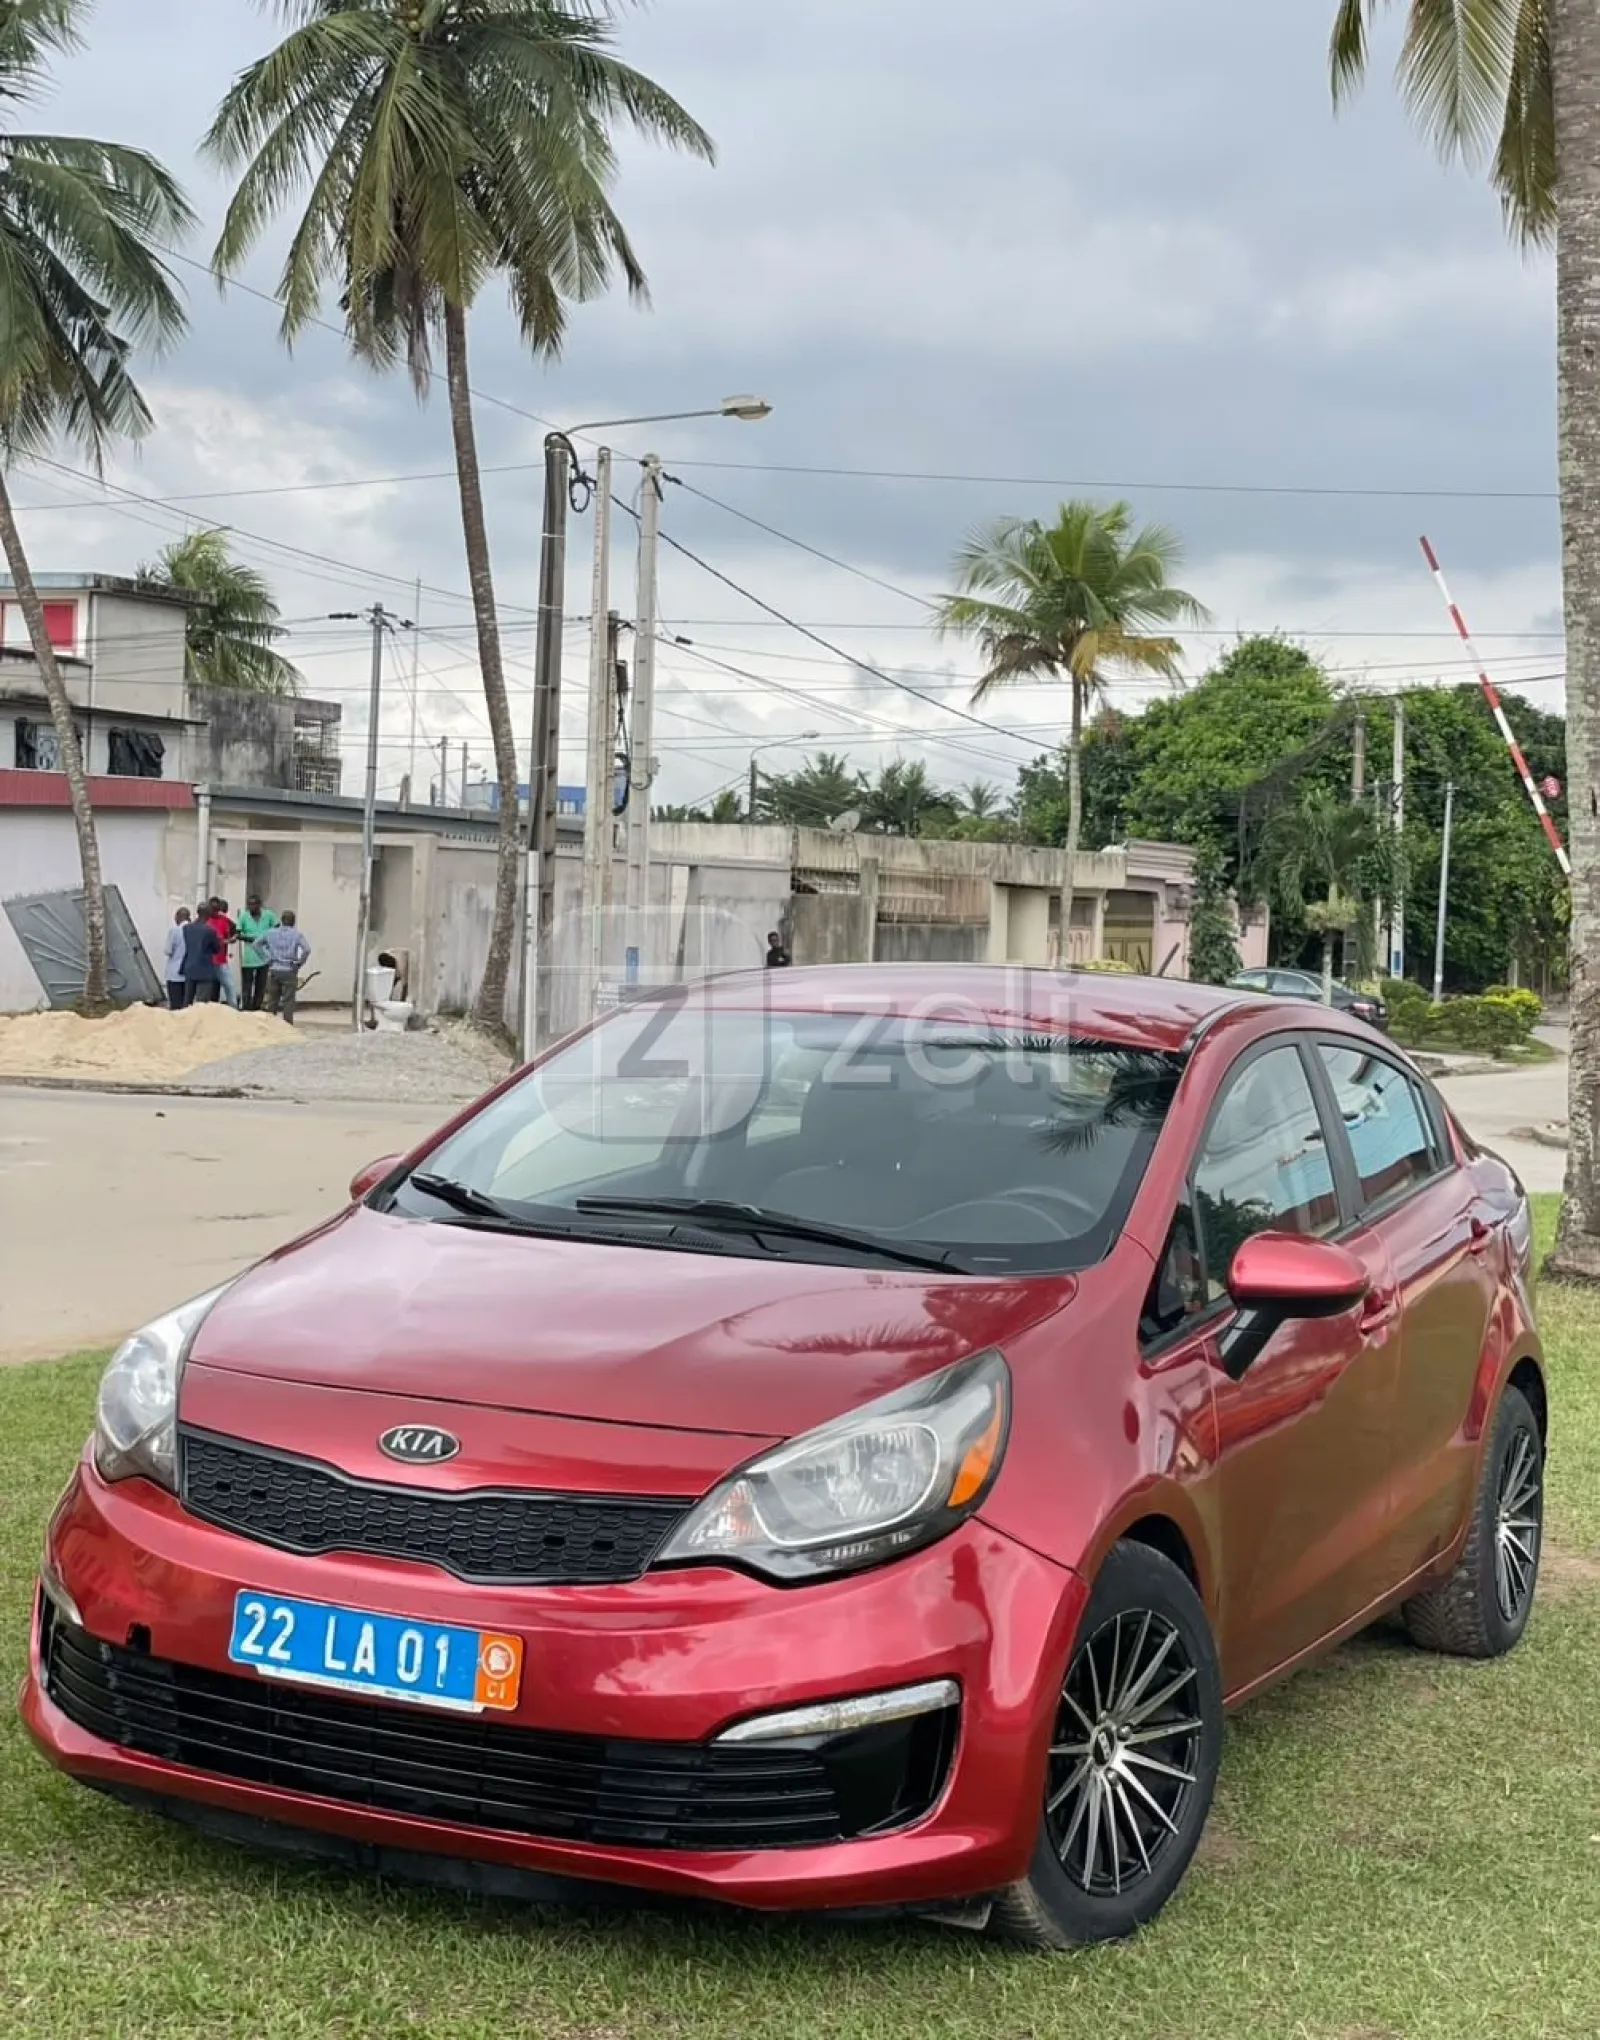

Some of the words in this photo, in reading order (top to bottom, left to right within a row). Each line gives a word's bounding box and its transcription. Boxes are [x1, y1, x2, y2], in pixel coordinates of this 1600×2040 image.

[390, 1430, 443, 1456] KIA
[240, 1602, 294, 1660] 22
[324, 1615, 376, 1676] LA
[396, 1629, 450, 1688] 01
